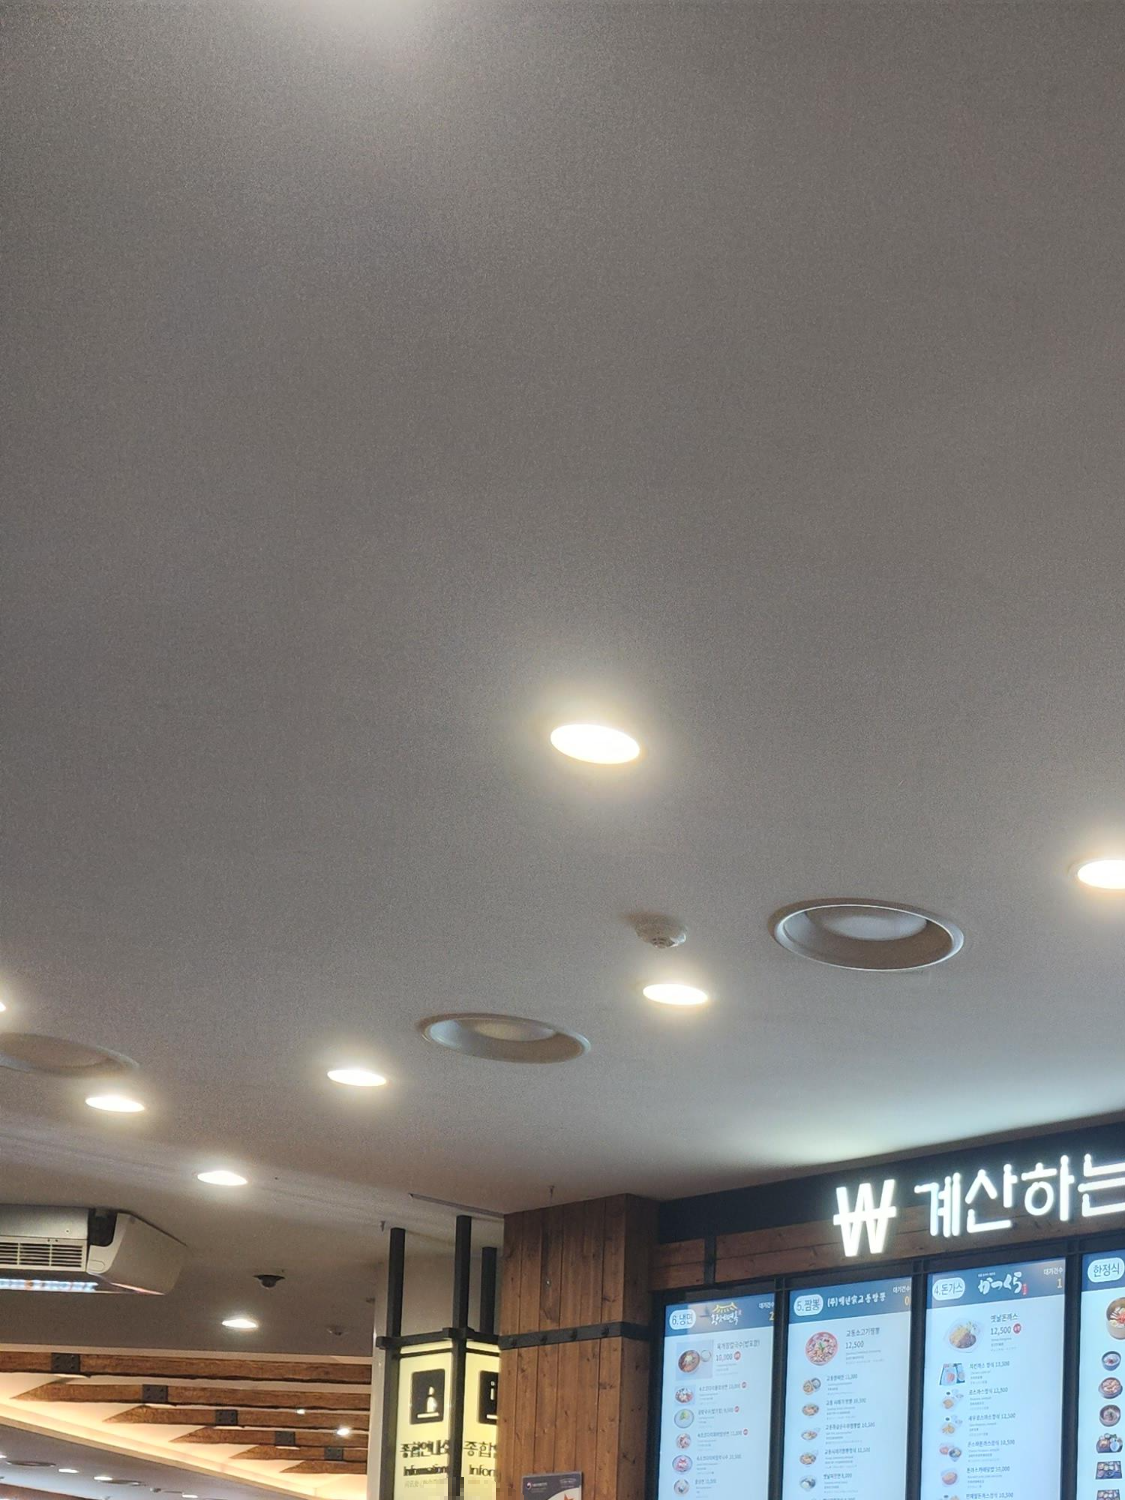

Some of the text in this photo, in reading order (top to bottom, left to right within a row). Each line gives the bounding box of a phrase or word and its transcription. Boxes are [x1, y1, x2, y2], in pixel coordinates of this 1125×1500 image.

[1093, 1262, 1120, 1279] 한정식
[934, 1282, 964, 1296] 4.돈가스
[1057, 1278, 1063, 1289] 1
[796, 1297, 821, 1313] 5.짬뽕
[990, 1325, 1012, 1336] 12,500
[845, 1340, 865, 1350] 12,500
